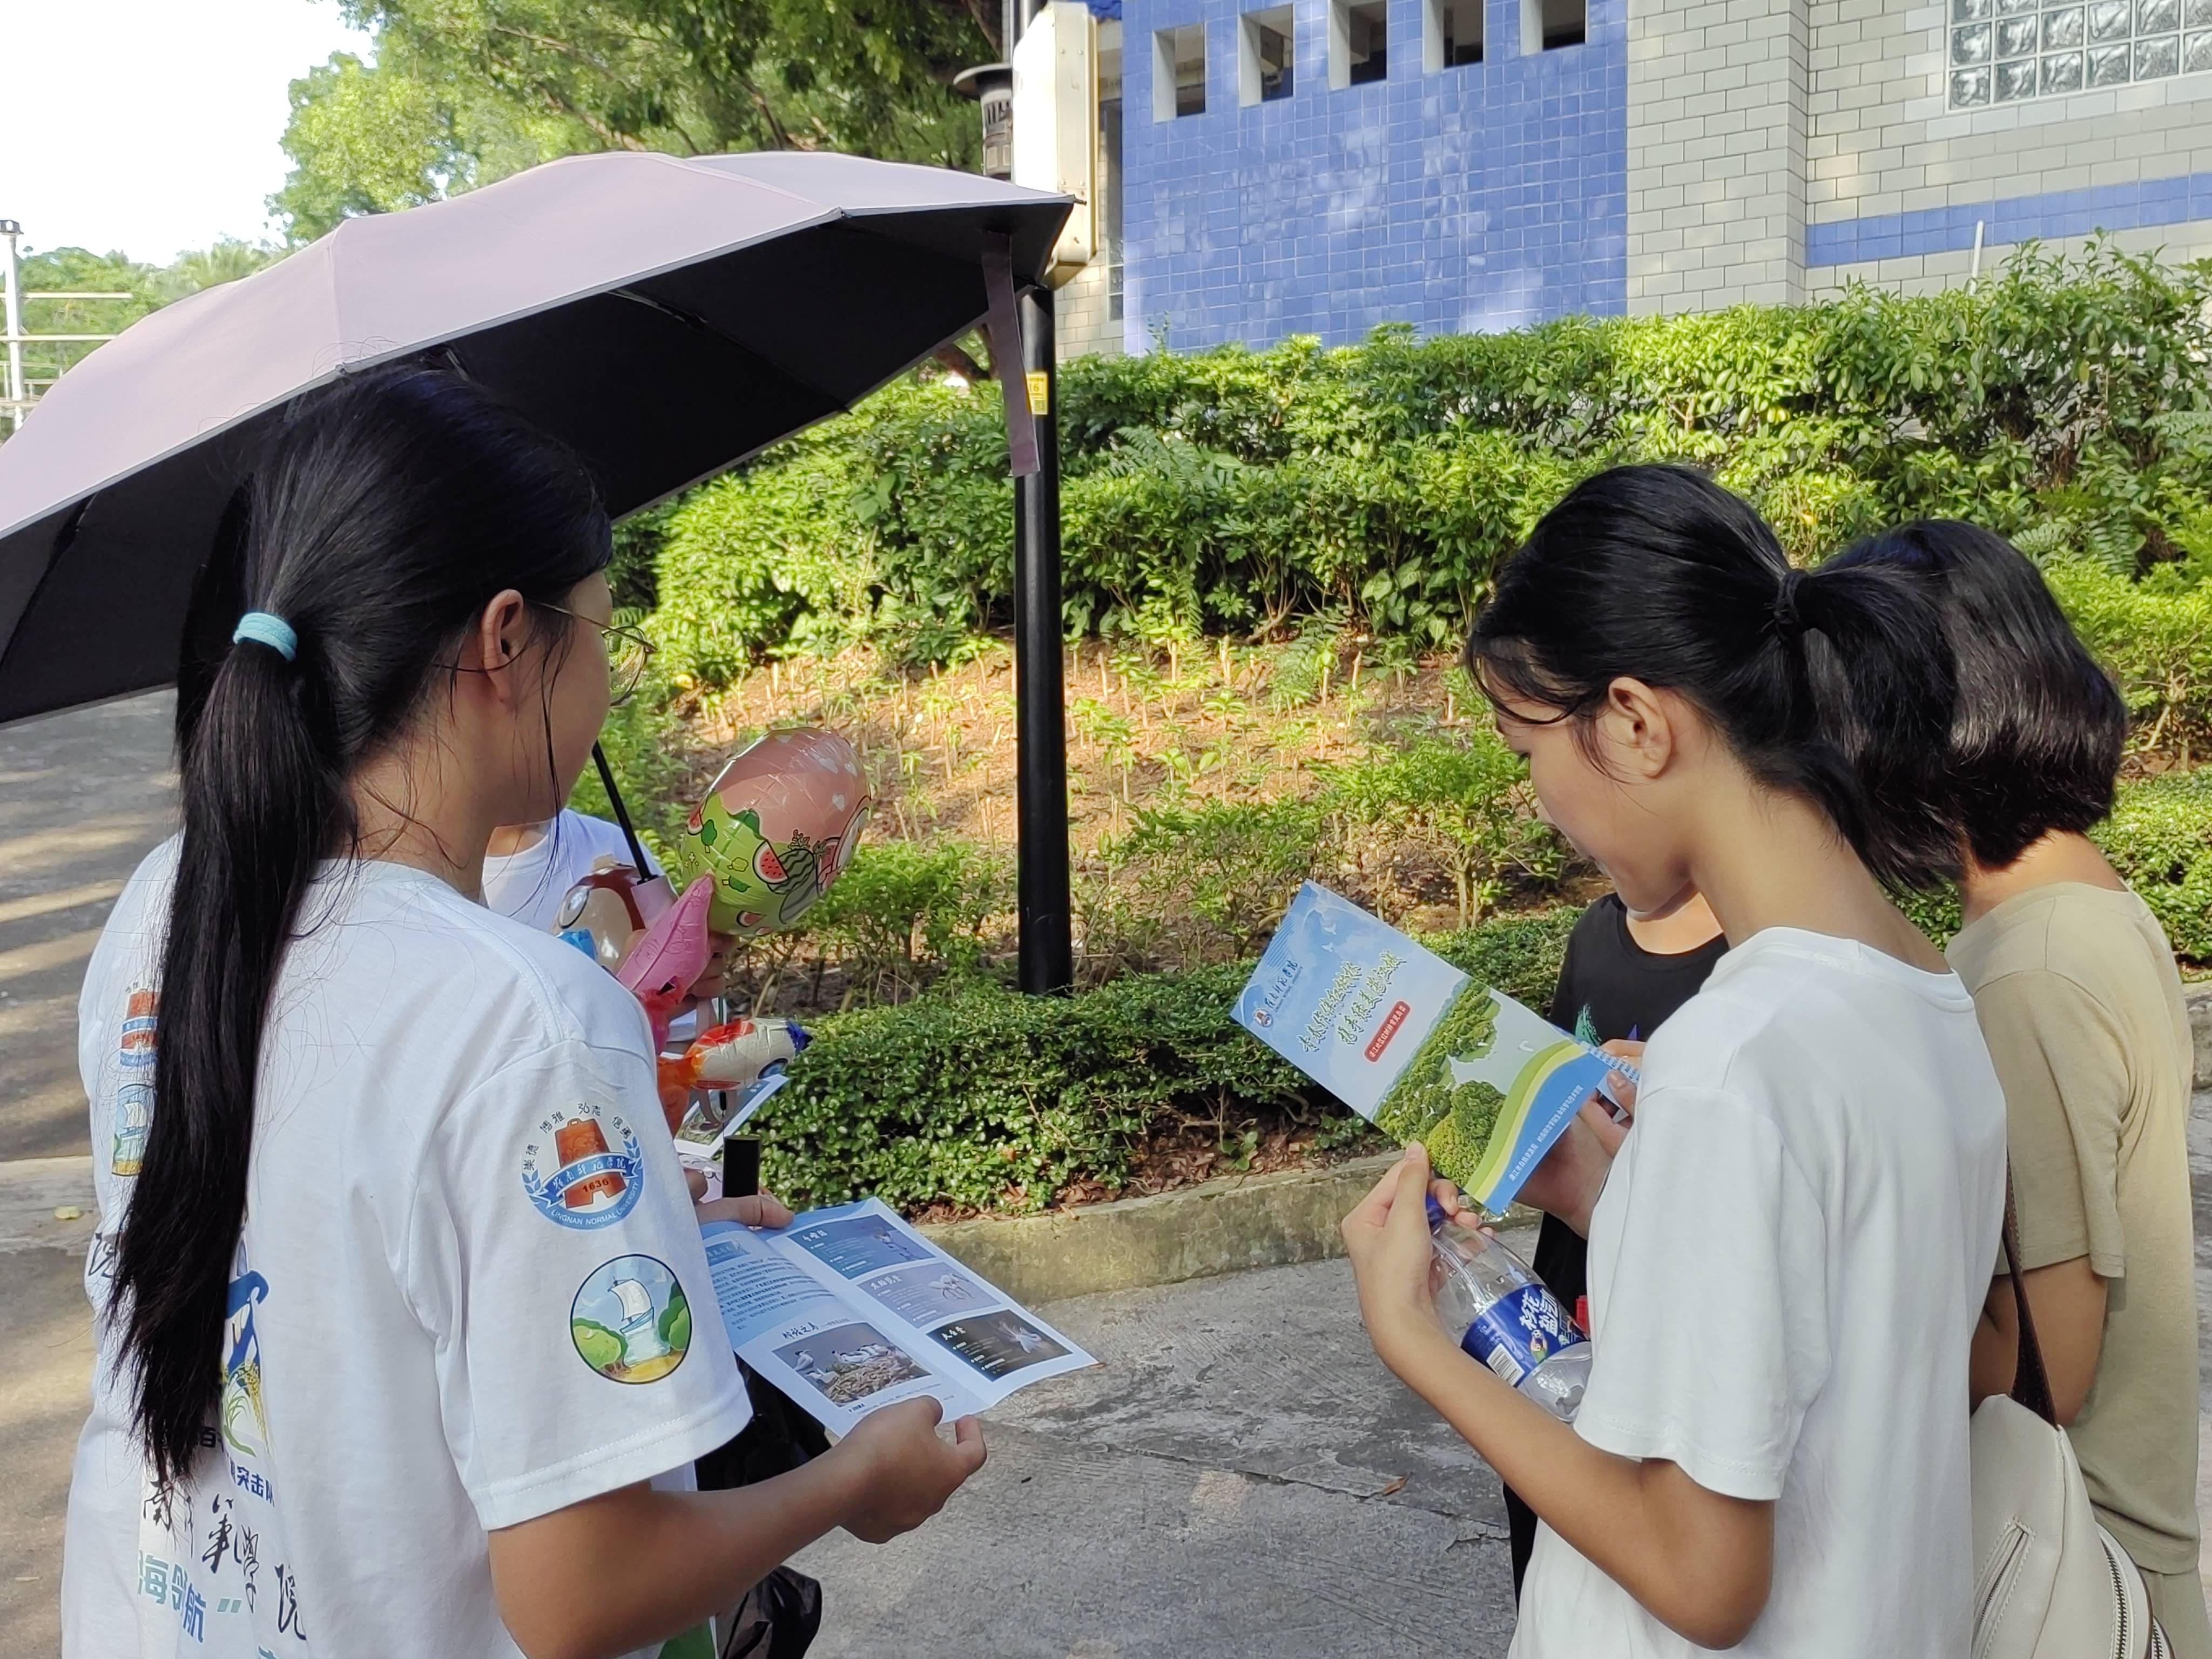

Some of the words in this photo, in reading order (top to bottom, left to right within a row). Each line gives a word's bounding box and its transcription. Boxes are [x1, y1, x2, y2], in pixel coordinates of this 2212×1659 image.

[582, 1179, 609, 1192] 1636
[551, 1209, 583, 1225] LINGNAN
[585, 1211, 617, 1225] NORMAL
